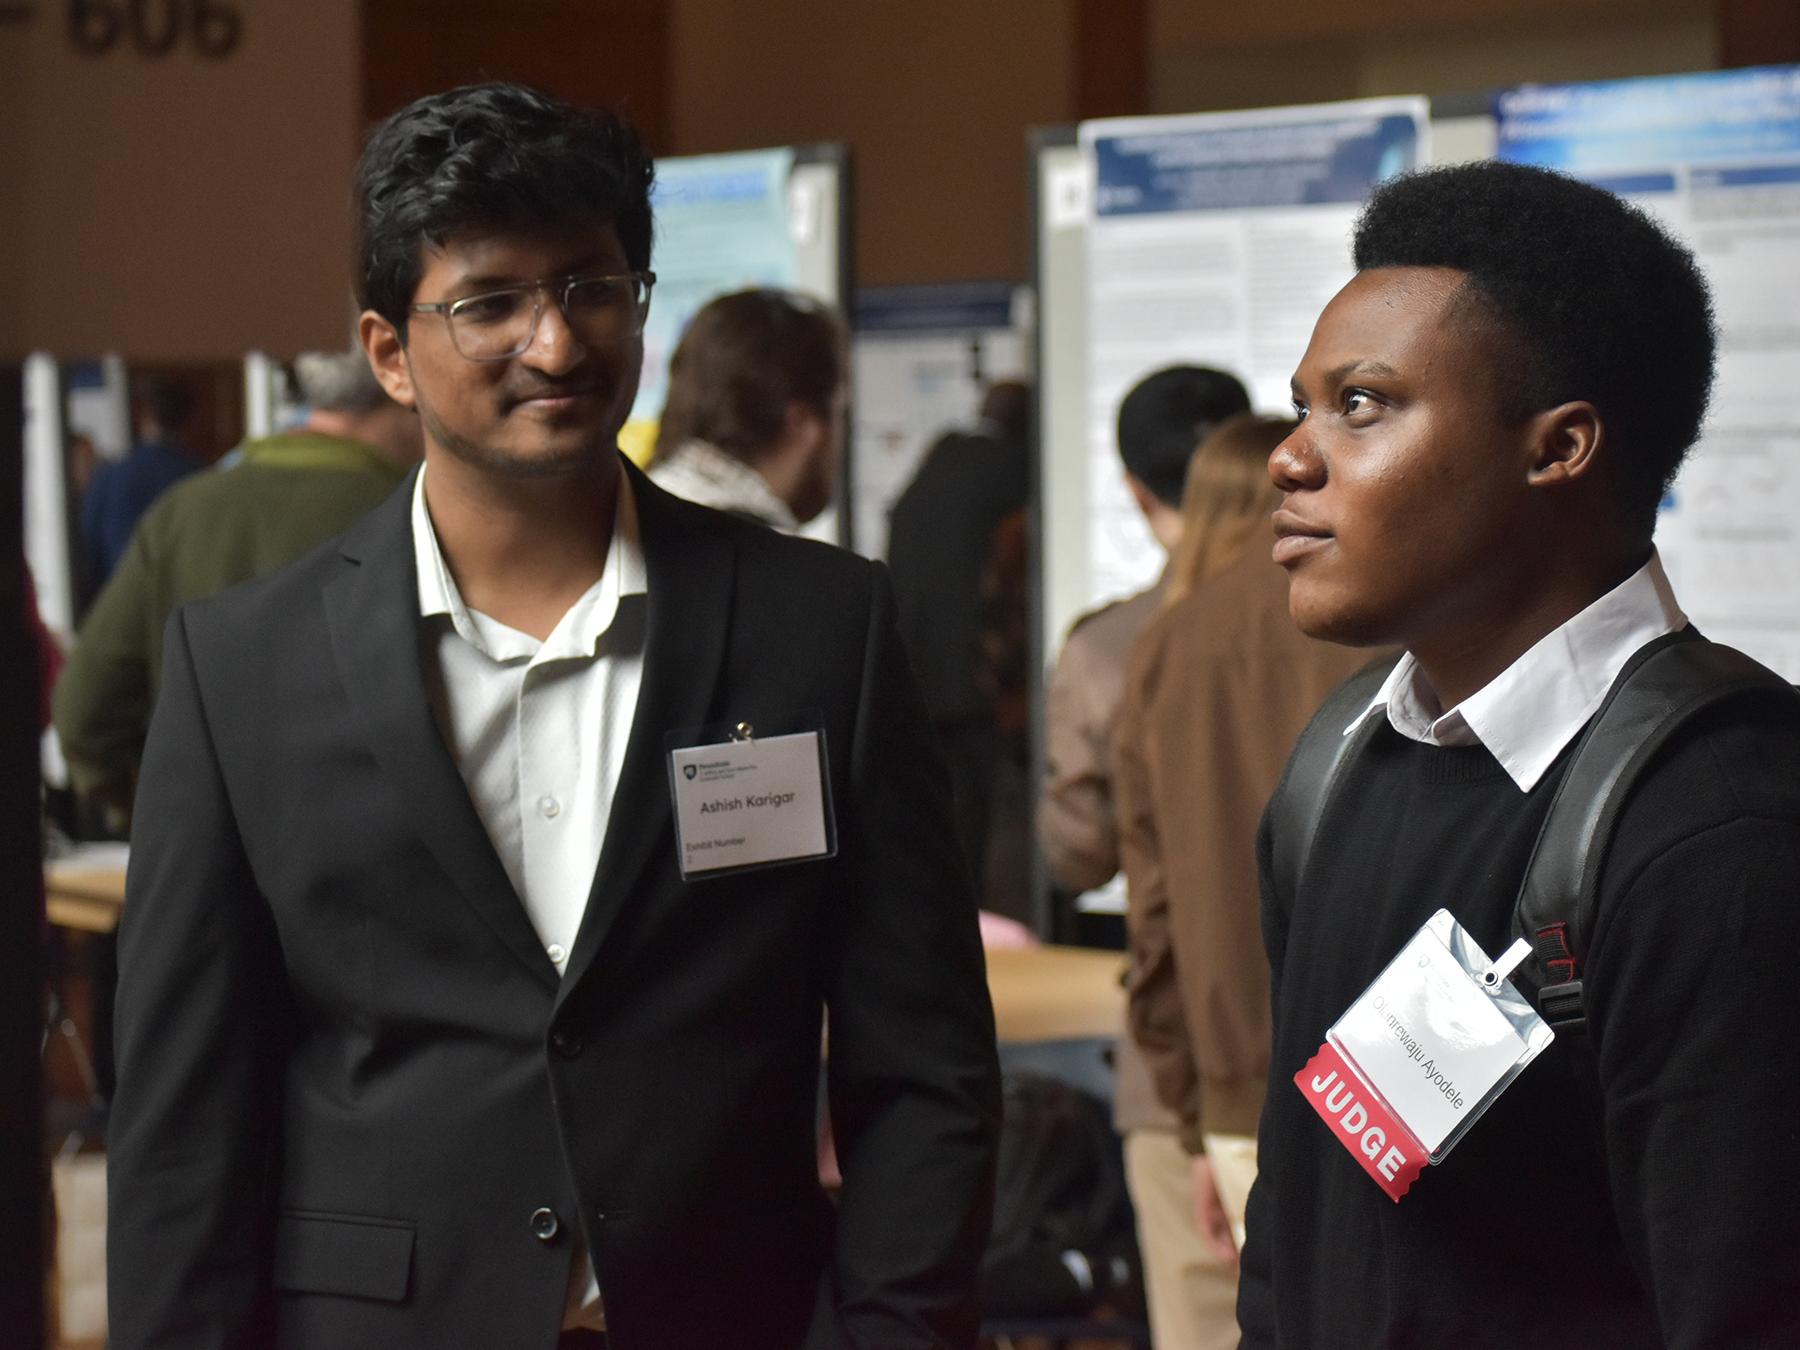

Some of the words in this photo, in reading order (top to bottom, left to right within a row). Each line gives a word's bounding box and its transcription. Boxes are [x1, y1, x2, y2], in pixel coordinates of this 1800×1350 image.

[700, 797, 743, 815] Ashish
[746, 791, 796, 809] Karigar
[714, 837, 746, 849] Number
[1372, 995, 1425, 1064] Olnrewaju
[1421, 1059, 1464, 1110] Ayodele
[1311, 1071, 1407, 1182] JUDGE
